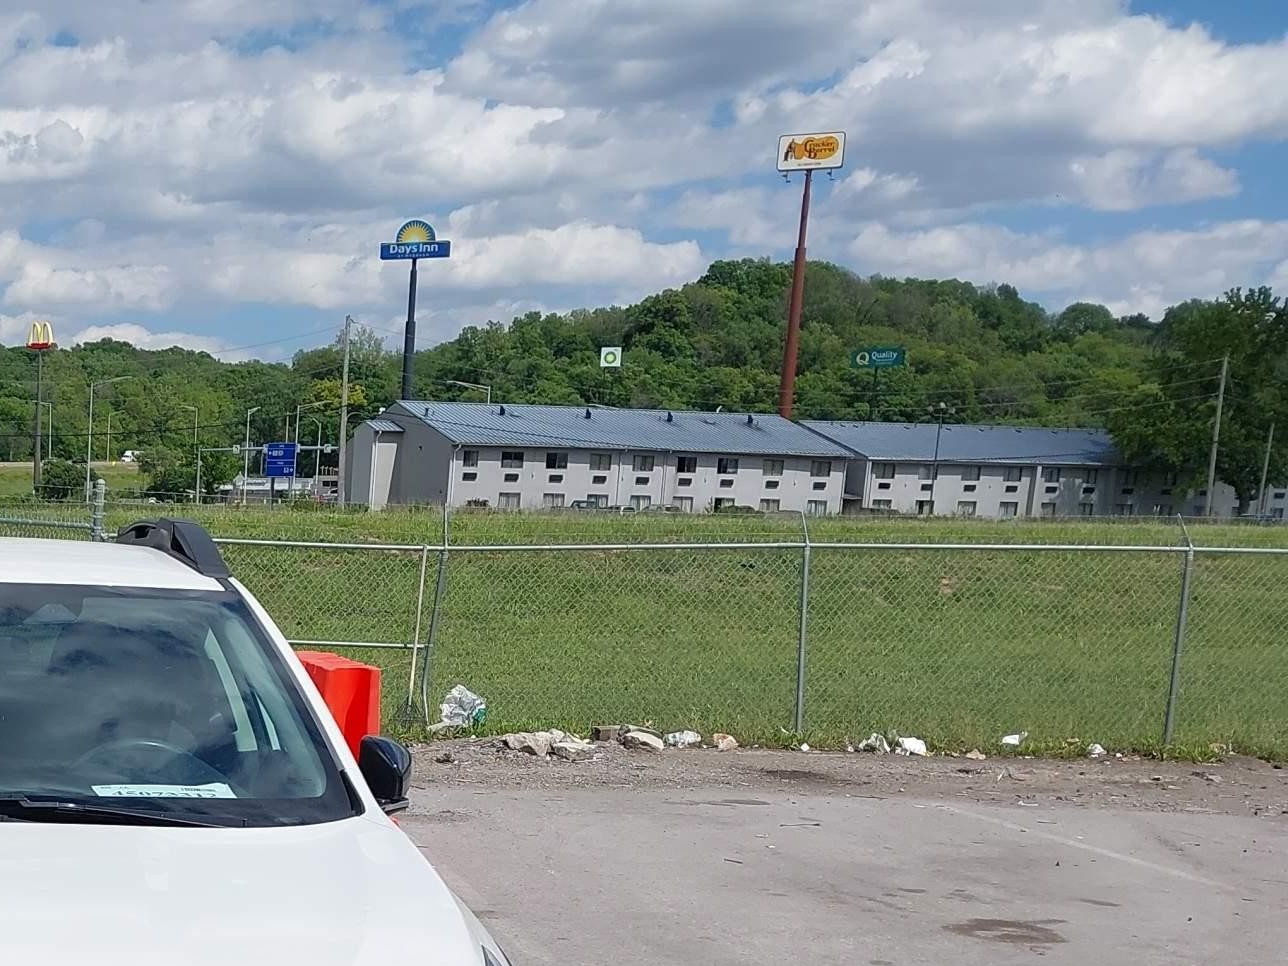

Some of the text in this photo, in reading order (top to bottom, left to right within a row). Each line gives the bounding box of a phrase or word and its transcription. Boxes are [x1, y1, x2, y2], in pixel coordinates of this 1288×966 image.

[389, 243, 439, 254] Days Inn
[872, 351, 898, 361] Quality
